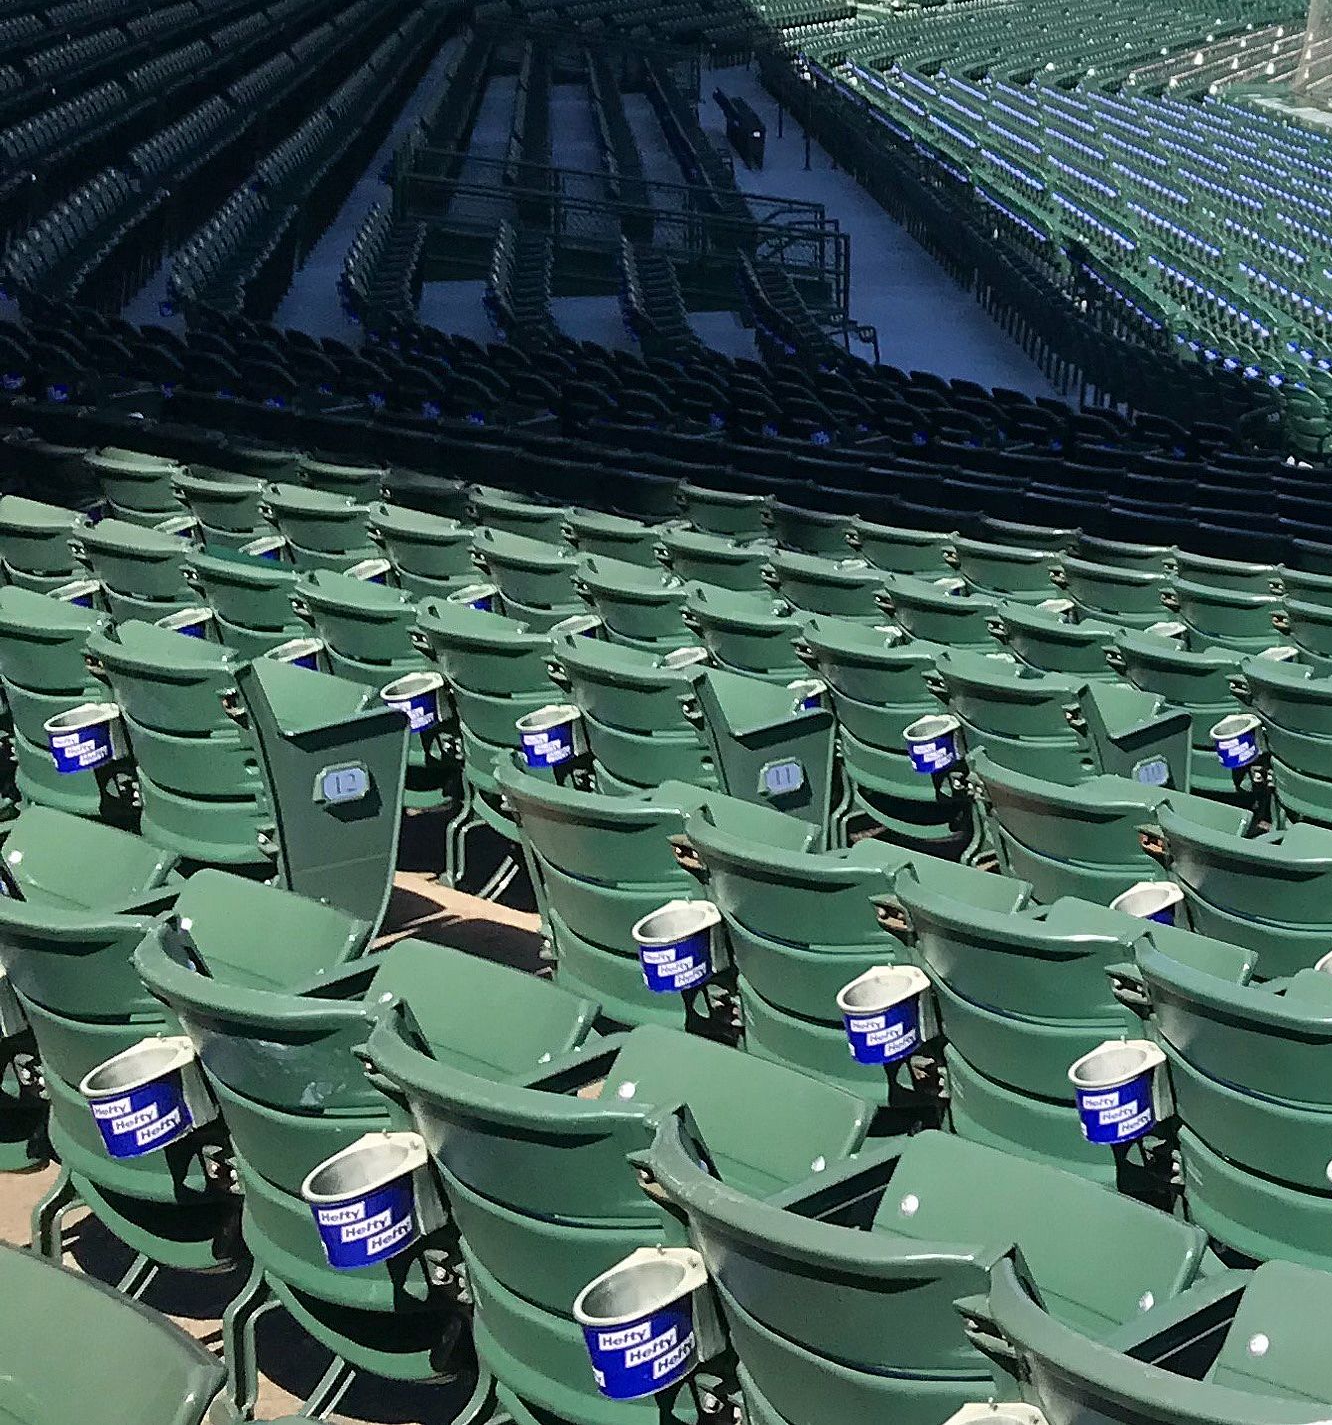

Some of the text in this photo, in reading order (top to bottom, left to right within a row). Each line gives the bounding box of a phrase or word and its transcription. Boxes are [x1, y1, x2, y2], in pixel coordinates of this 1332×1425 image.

[335, 773, 357, 794] 12
[775, 766, 791, 785] 11
[94, 1103, 127, 1117] Hefty
[115, 1108, 154, 1131] Hefty
[1102, 1106, 1134, 1121] Hefty
[140, 1111, 178, 1140] Hefty
[320, 1208, 361, 1223] Hefty
[344, 1215, 388, 1239] Hefty
[370, 1220, 411, 1250] Hefty
[601, 1328, 647, 1347] Hefty
[629, 1333, 674, 1363] Hefty
